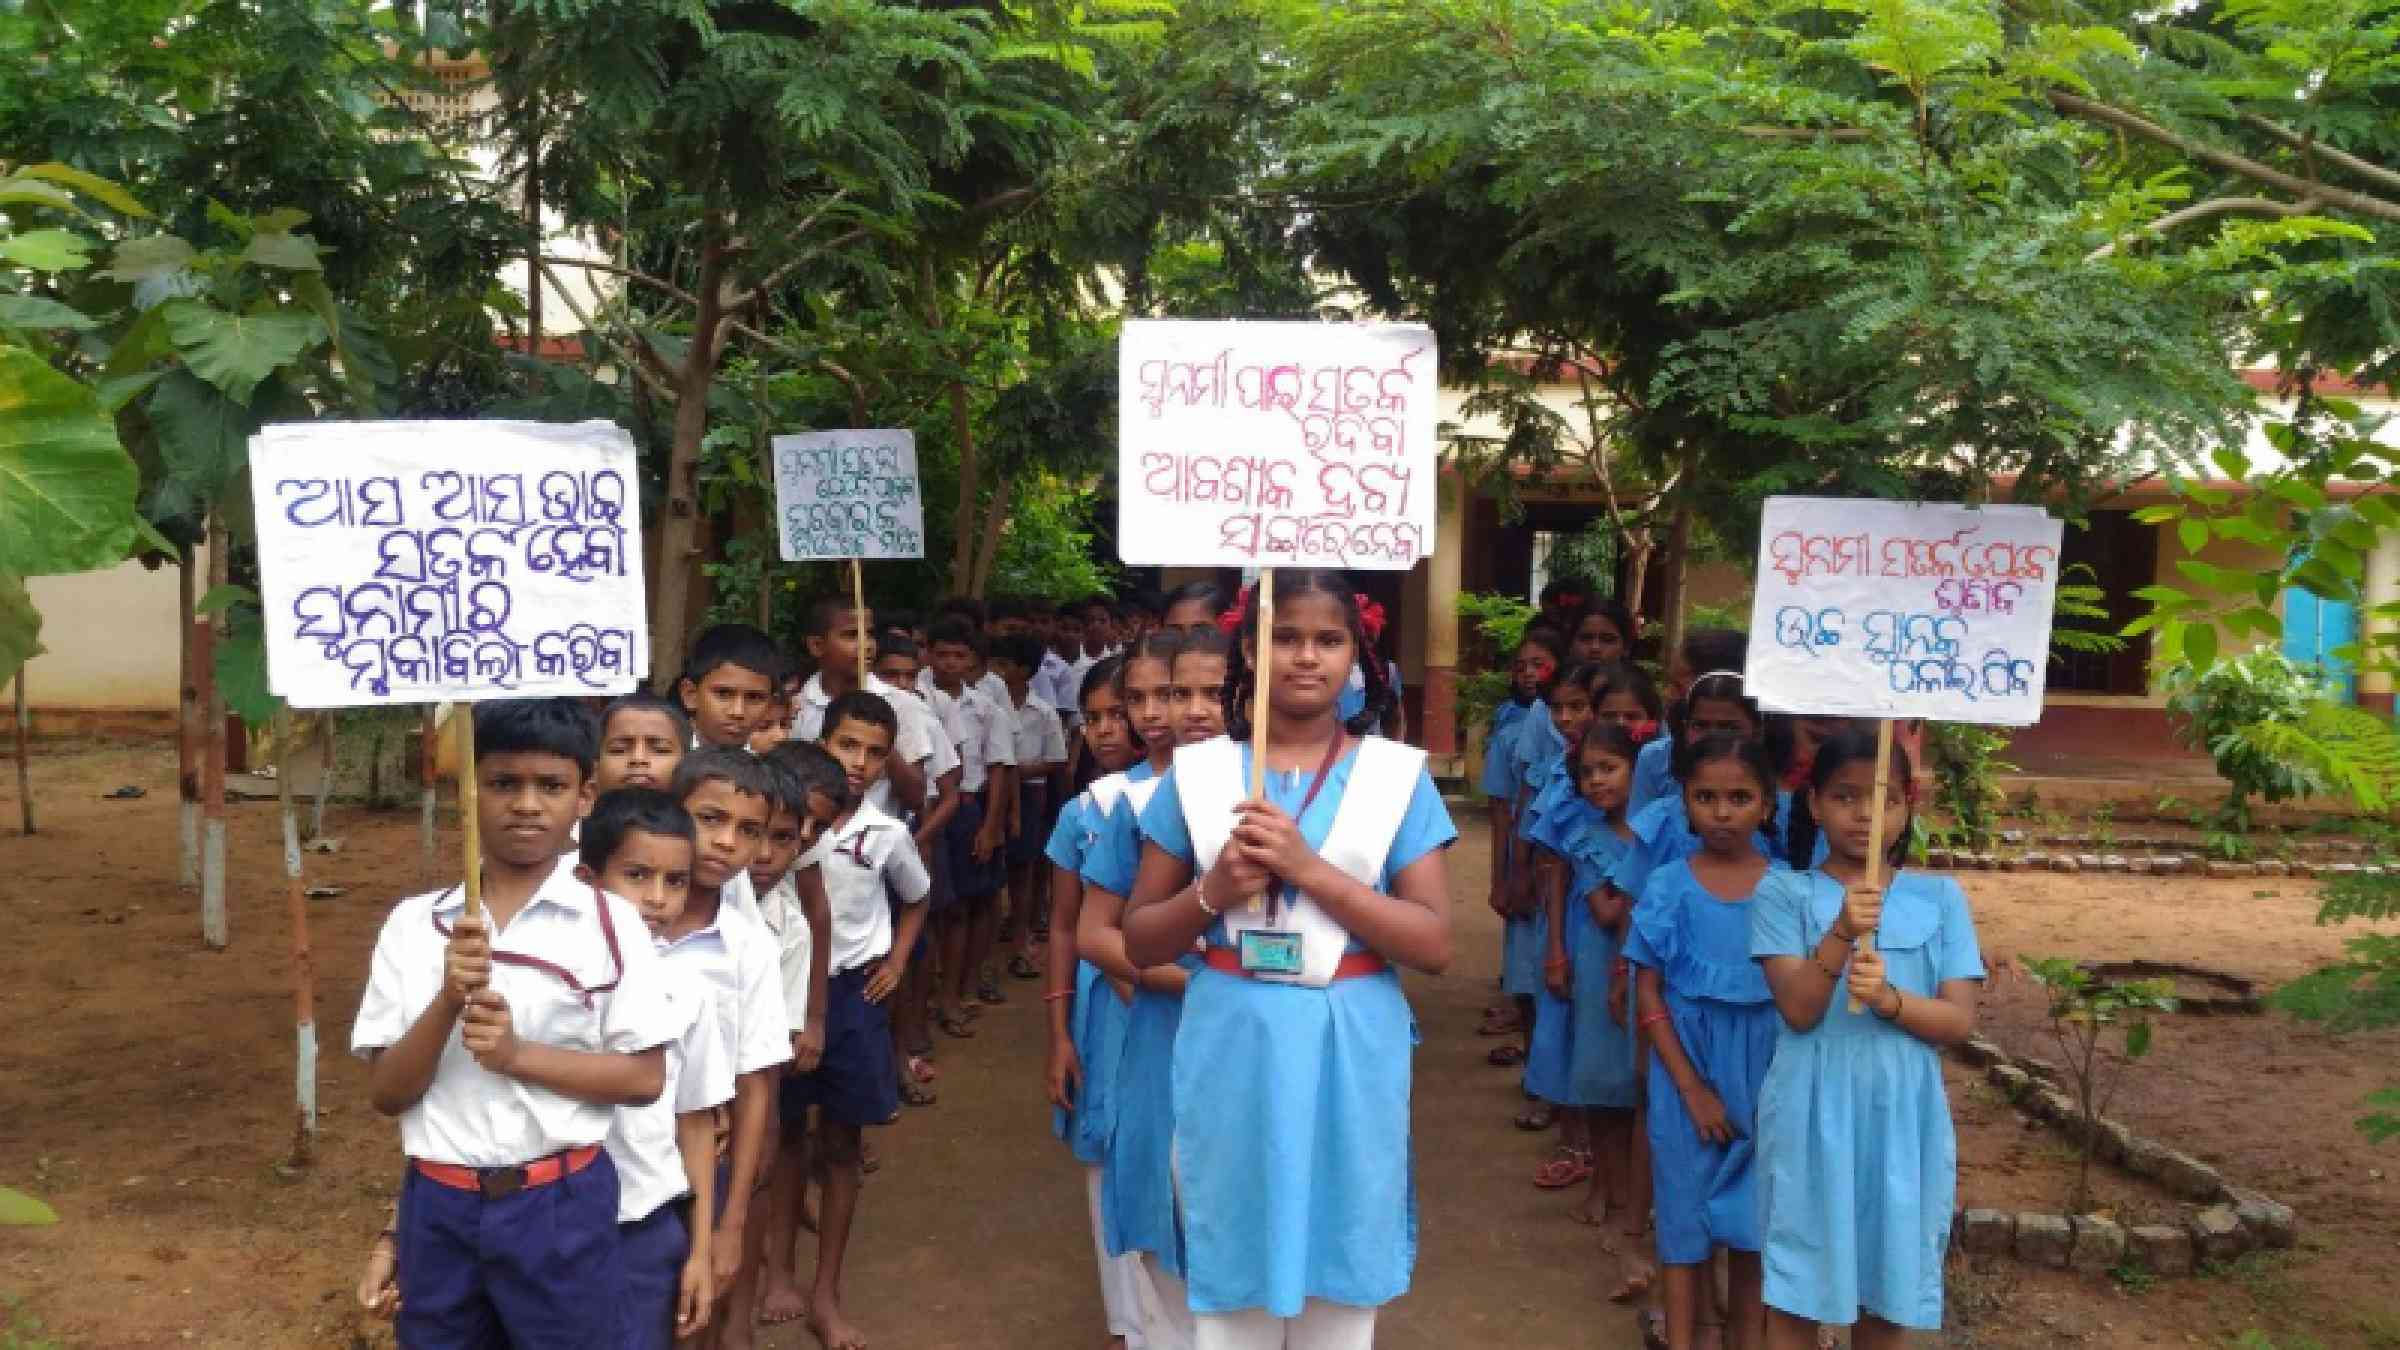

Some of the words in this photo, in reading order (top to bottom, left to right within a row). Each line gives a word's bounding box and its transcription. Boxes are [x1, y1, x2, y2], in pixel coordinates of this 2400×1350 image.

[1308, 347, 1424, 414] ସତର୍କ
[276, 477, 403, 527] ଆସ
[420, 470, 526, 526] ଆସ
[374, 519, 537, 582] ସତର୍କ
[526, 523, 628, 582] ହେବା
[1880, 525, 1981, 577] ସତର୍କ
[533, 624, 634, 687] କରିବା
